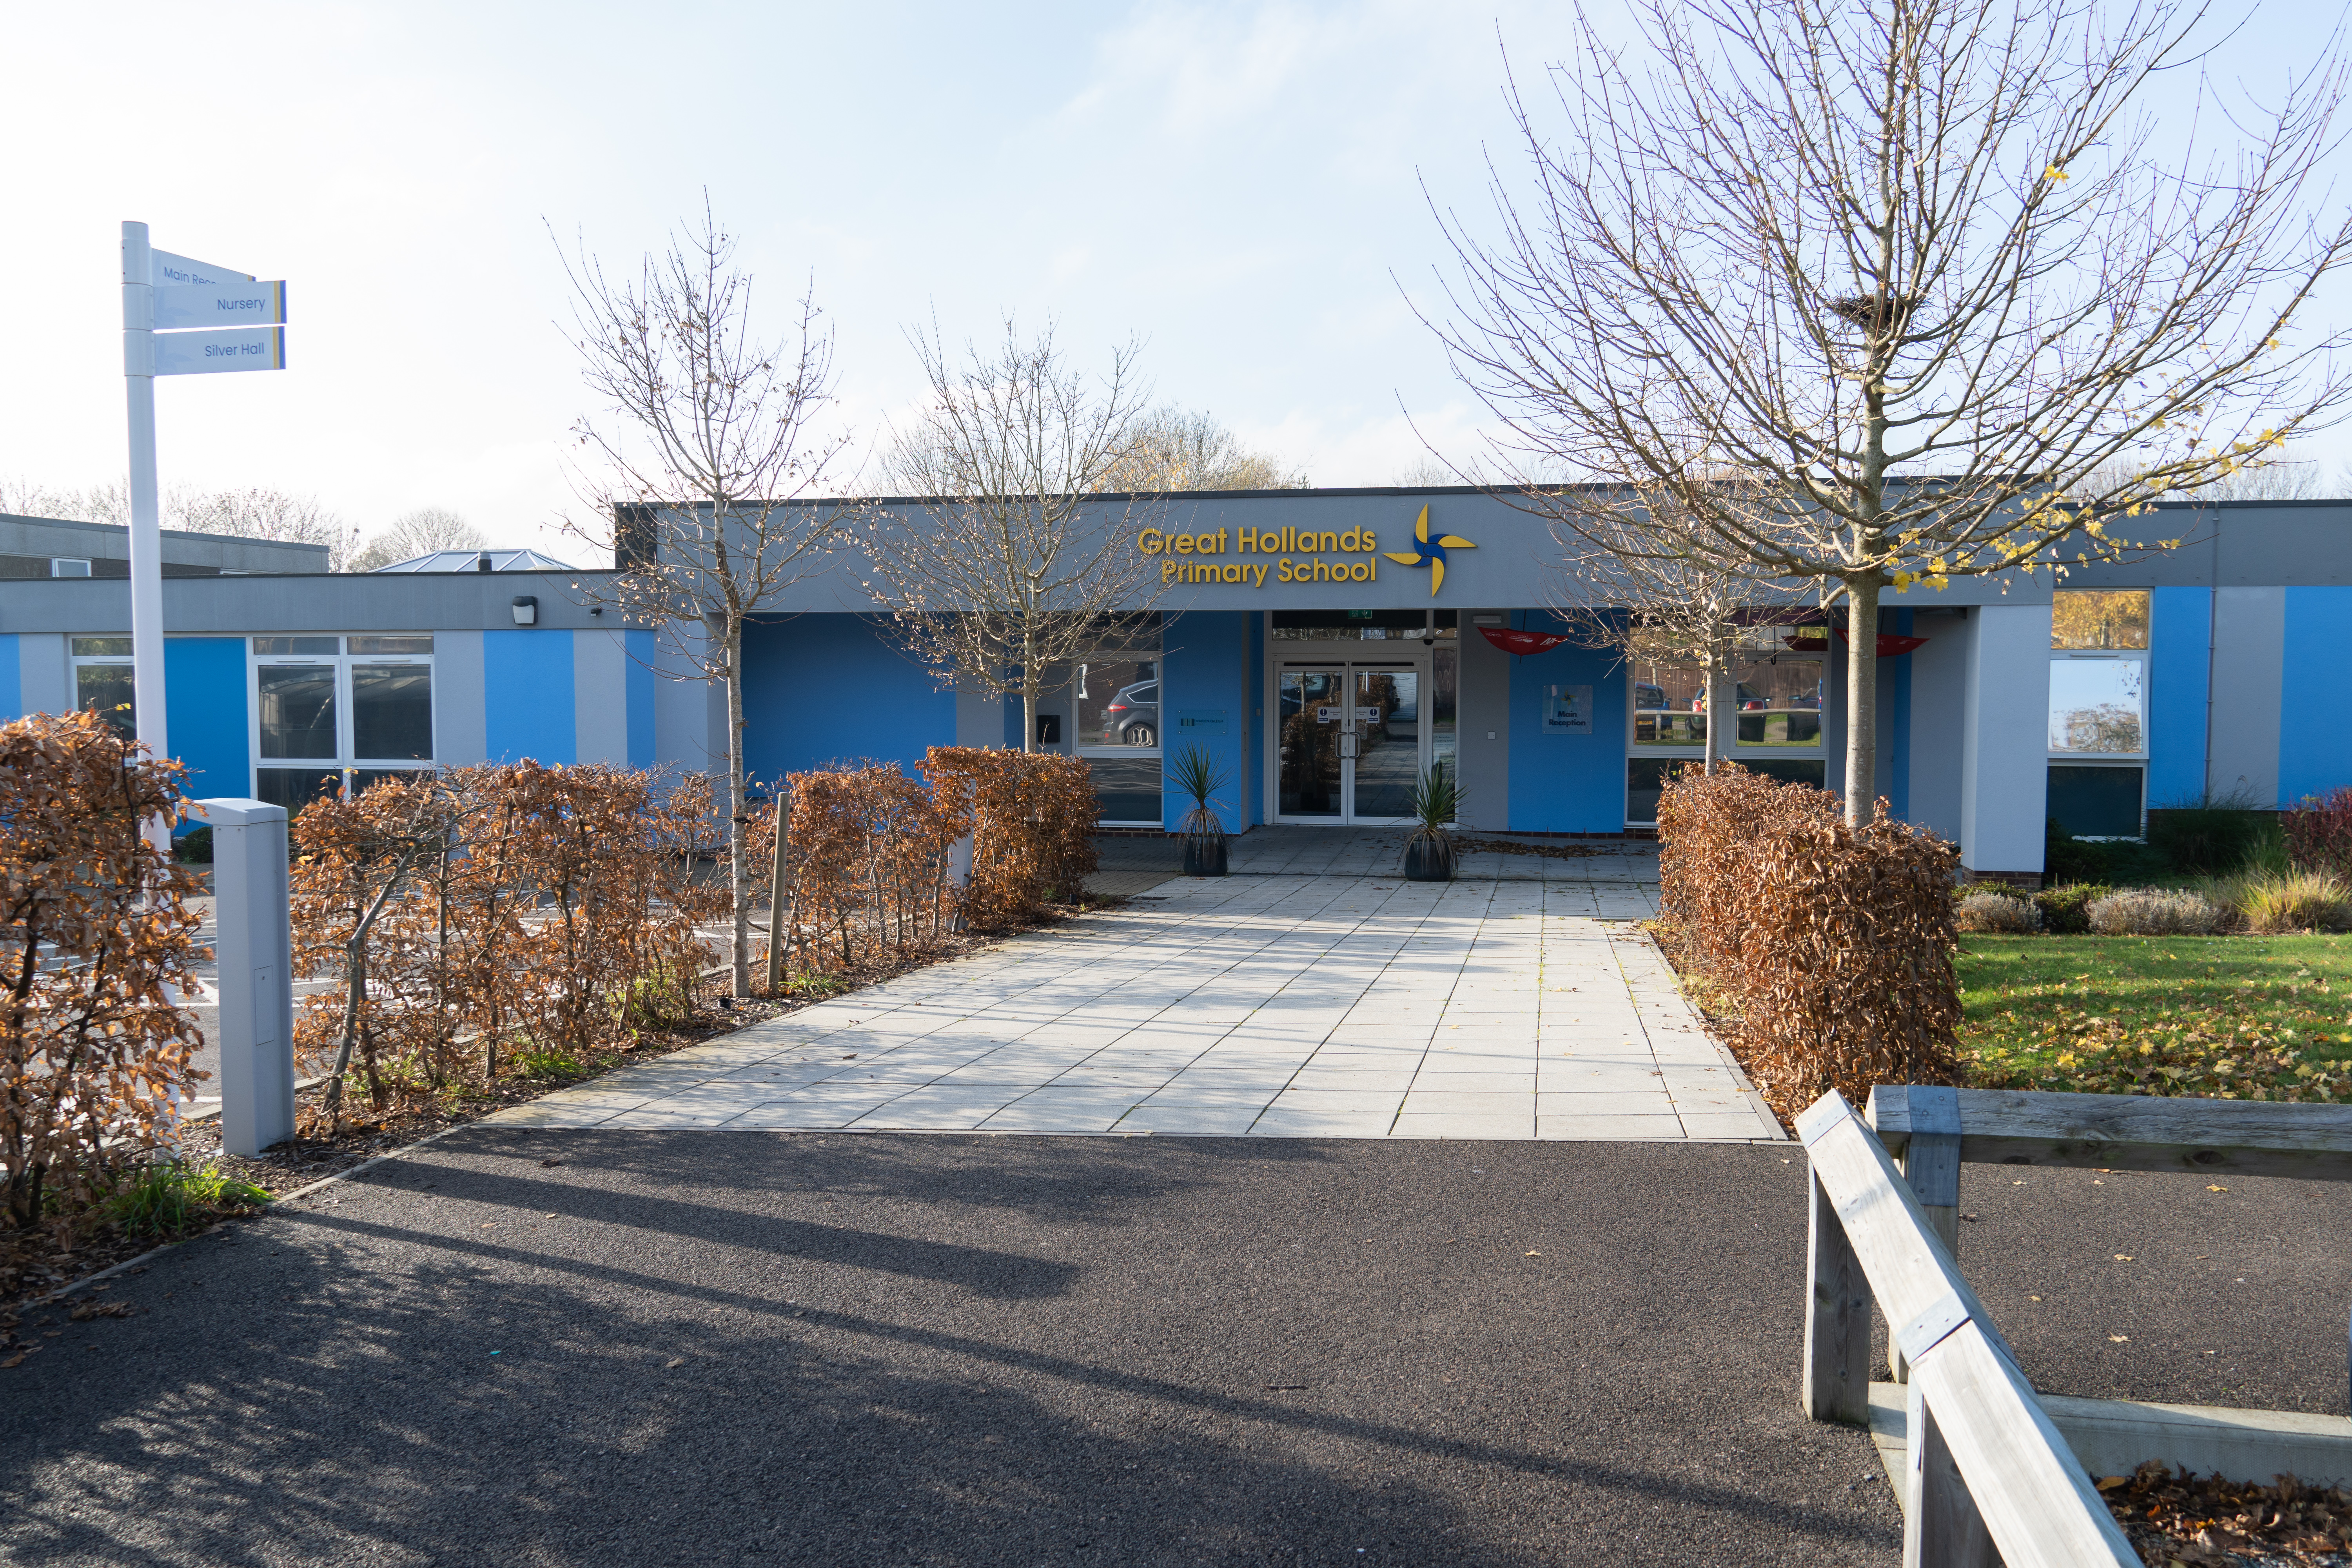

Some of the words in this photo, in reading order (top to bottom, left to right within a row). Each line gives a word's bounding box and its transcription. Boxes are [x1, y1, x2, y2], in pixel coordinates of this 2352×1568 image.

[164, 266, 189, 283] Main
[217, 299, 265, 312] Nursery
[205, 345, 238, 357] Silver
[241, 342, 264, 355] Hall
[1137, 527, 1227, 555] Great
[1238, 525, 1376, 554] Hollands
[1161, 559, 1269, 588] Primary
[1278, 557, 1376, 583] School
[1549, 719, 1586, 727] Reception
